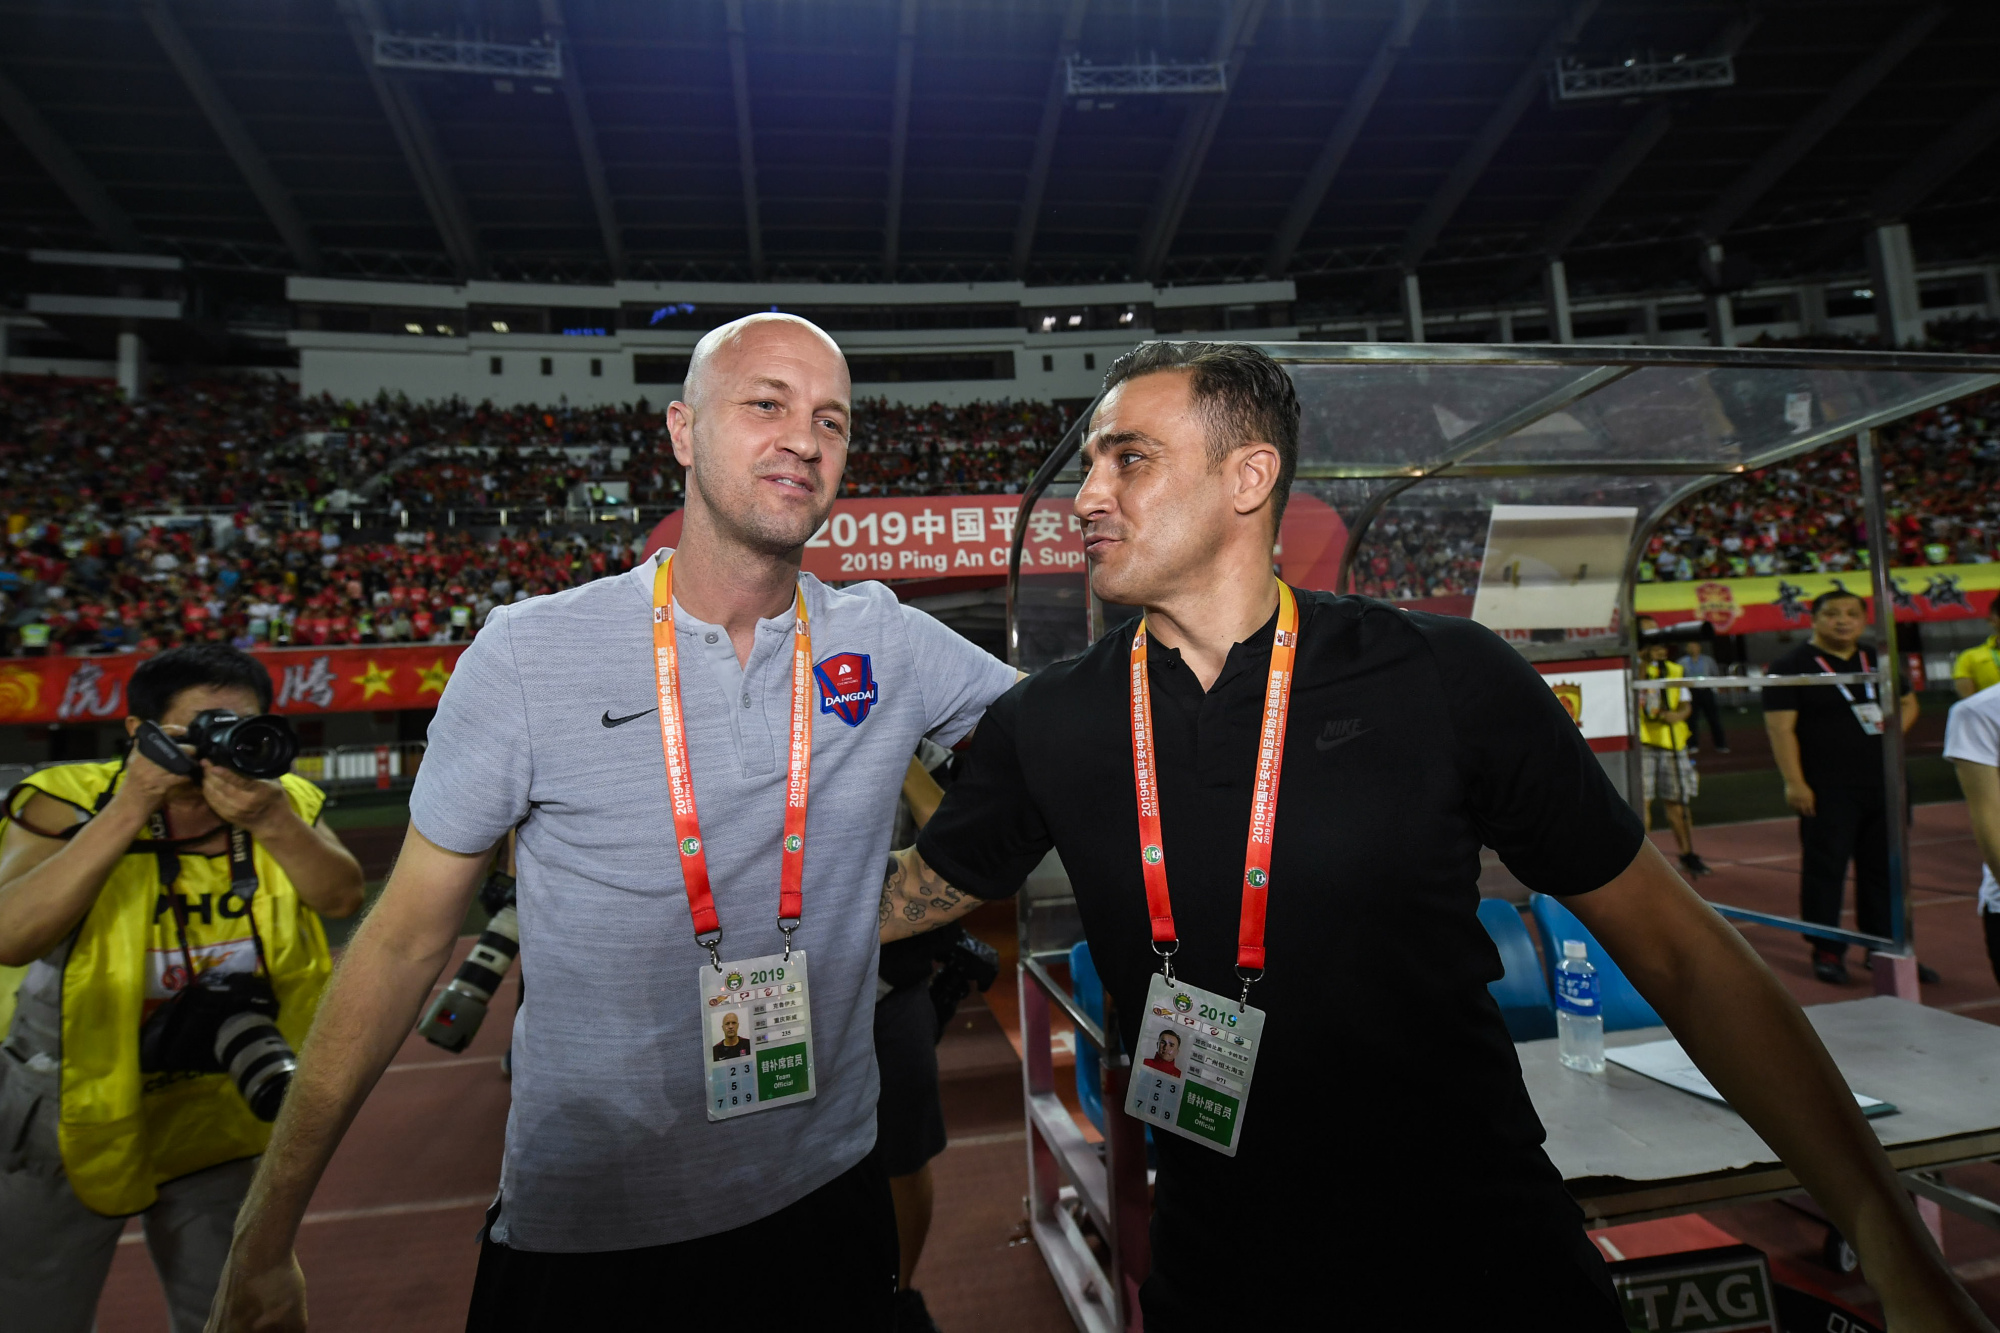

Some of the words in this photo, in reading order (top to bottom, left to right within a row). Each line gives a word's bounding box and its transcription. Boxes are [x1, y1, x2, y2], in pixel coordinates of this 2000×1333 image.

[841, 552, 893, 572] 2019
[899, 550, 947, 572] Ping
[954, 549, 983, 567] An
[672, 686, 680, 721] Association
[825, 690, 874, 707] DANGDAI
[674, 721, 683, 747] Football
[1276, 711, 1284, 747] Association
[1323, 719, 1361, 737] NIKE
[1272, 748, 1280, 773] Football
[1269, 775, 1277, 800] Chinese
[751, 968, 785, 985] 2019
[1198, 1004, 1237, 1027] 2019
[731, 1067, 736, 1076] 2
[744, 1065, 750, 1073] 3
[761, 1054, 803, 1074] 替补席官员
[774, 1080, 793, 1089] Official
[776, 1073, 790, 1081] Team
[731, 1082, 737, 1091] 5
[1155, 1079, 1162, 1088] 2
[1170, 1085, 1176, 1094] 3
[717, 1099, 724, 1108] 7
[732, 1096, 738, 1105] 8
[745, 1093, 751, 1102] 9
[1153, 1093, 1159, 1101] 5
[1187, 1091, 1232, 1120] 替补席官员
[1137, 1100, 1143, 1108] 7
[1150, 1105, 1157, 1114] 8
[1164, 1111, 1170, 1120] 9
[1198, 1112, 1215, 1123] Team
[1194, 1118, 1216, 1132] Official
[1629, 1274, 1759, 1331] TAG
